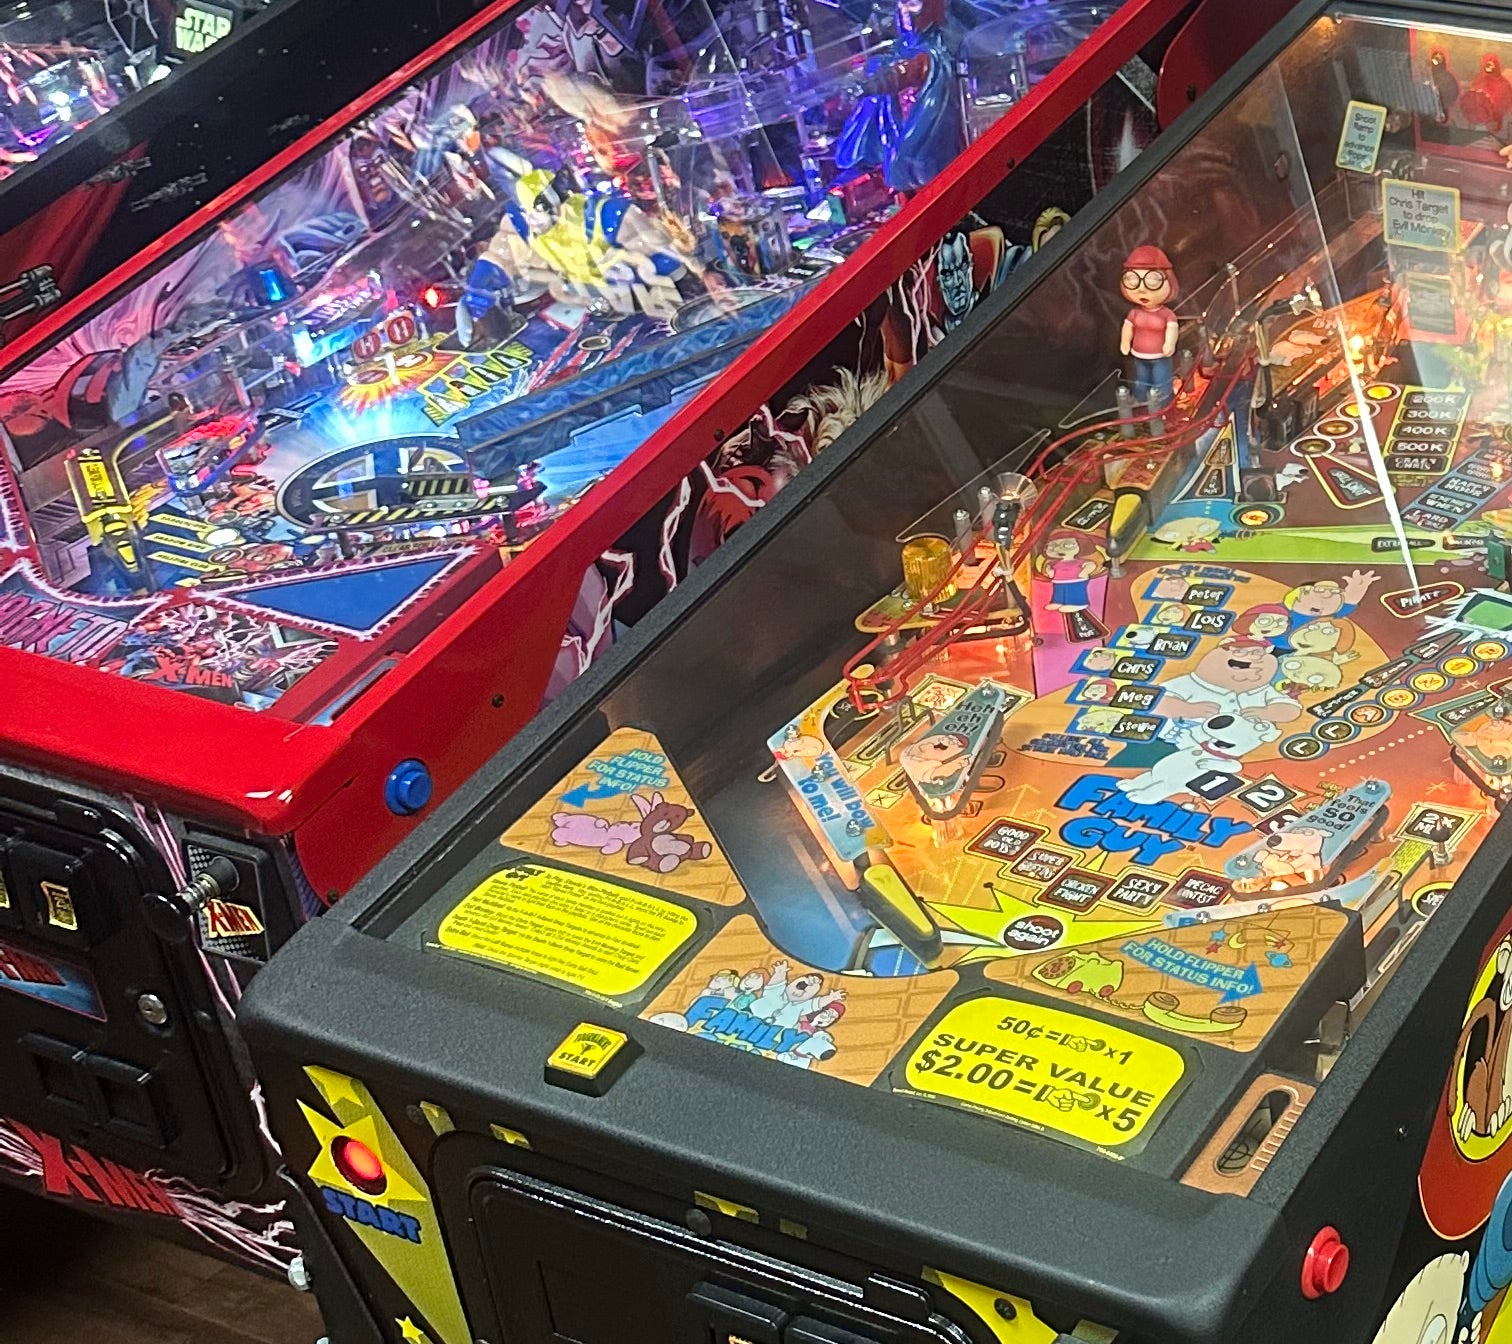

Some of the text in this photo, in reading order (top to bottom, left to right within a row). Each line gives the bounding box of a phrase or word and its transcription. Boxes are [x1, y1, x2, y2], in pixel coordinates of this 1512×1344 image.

[1389, 196, 1449, 215] Chris Target
[149, 658, 234, 688] X-MEN
[610, 756, 666, 776] FLIPPER
[628, 749, 665, 765] HOLD
[587, 760, 669, 788] FOR STATUS
[598, 776, 637, 792] INFO!
[1200, 775, 1229, 792] 1
[830, 778, 858, 802] will
[845, 798, 875, 830] bow
[1245, 785, 1287, 809] 2
[1330, 798, 1369, 816] feels
[1347, 793, 1376, 807] That
[813, 792, 842, 824] me!
[1054, 774, 1254, 848] FAMILY
[1322, 807, 1356, 823] SO
[1306, 814, 1352, 832] good!
[1059, 815, 1186, 866] GUY
[1122, 878, 1162, 894] SEXY
[1116, 888, 1152, 905] PARTY
[203, 899, 265, 938] X-MEN
[1008, 929, 1051, 947] again
[1014, 921, 1060, 939] shoot
[1123, 942, 1254, 995] FOR STATUS INFO!
[1146, 938, 1245, 980] HOLD FLIPPER
[684, 995, 814, 1054] FAMILY
[558, 1052, 597, 1068] START
[933, 1032, 1156, 1108] SUPER VALUE
[322, 1186, 422, 1245] START
